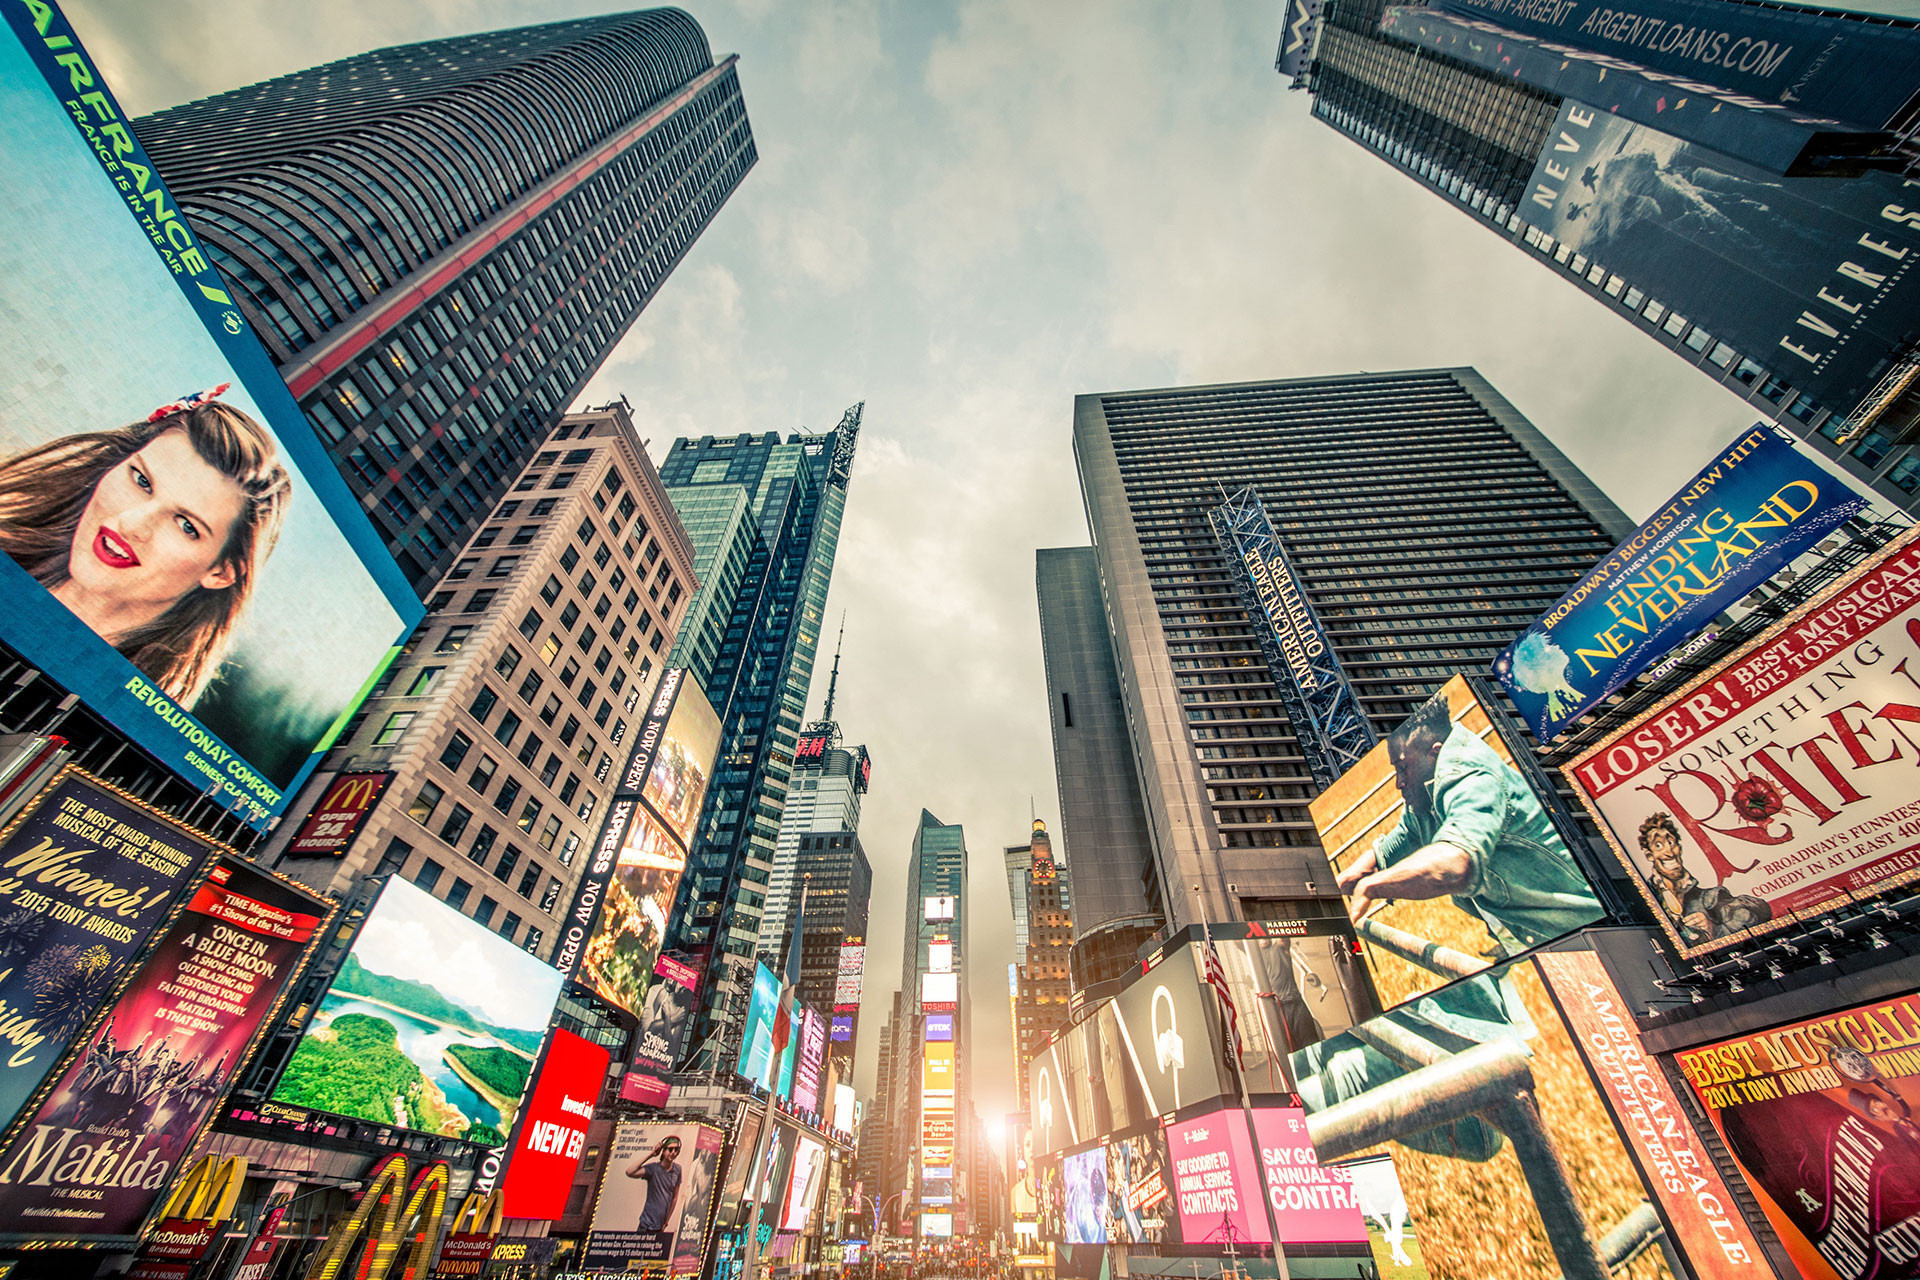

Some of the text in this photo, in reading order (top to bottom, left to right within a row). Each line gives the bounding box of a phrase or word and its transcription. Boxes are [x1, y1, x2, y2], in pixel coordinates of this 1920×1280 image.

[1579, 8, 1793, 78] ARGENTLOANS.COM
[1532, 105, 1595, 209] NEVE
[66, 100, 183, 275] FRANCE IS IN THE AIR
[1543, 430, 1767, 630] BROADWAY'S BIGGEST NEW HIT!
[1608, 513, 1697, 591] MATTHEW MORRISON
[1574, 479, 1819, 677] NEVERLAND
[1603, 507, 1736, 619] FINDING
[1244, 547, 1318, 689] AMERICAN EAGLE
[1267, 556, 1324, 658] OUTFITTERS
[1744, 577, 1920, 699] 2015 TONY AWAR
[1732, 637, 1799, 687] BEST
[626, 668, 682, 791] XPRESS NOW OPEN
[1658, 638, 1885, 780] SOMETHING
[125, 676, 281, 806] REVOLUTIONAY COMFORT
[1581, 680, 1742, 793] LOSER!
[60, 797, 193, 867] THE MOST AWARD-WINNING
[312, 822, 345, 836] 24
[319, 813, 356, 821] OPEN
[52, 813, 181, 878] MUSICAL OF THE SEASON!
[297, 838, 347, 847] HOURS
[1751, 868, 1807, 898] COMEDY
[1807, 861, 1825, 875] IN
[1827, 852, 1847, 869] AT
[1846, 832, 1896, 859] LEAST
[4, 836, 170, 918] Winner!
[12, 889, 137, 944] 2015 TONY AWARDS
[209, 904, 295, 937] #1 Show of the Year!
[224, 895, 293, 926] TIME Magazine's
[575, 879, 601, 925] NOW
[1267, 920, 1308, 928] MARRIOTT
[250, 941, 269, 957] IN
[557, 927, 584, 980] OPEN
[1269, 927, 1307, 935] MARQUIS
[178, 961, 254, 995] OUT BLAZING AND
[181, 933, 278, 980] A BLUE MOON,
[191, 954, 256, 983] A SHOW COMES
[157, 981, 247, 1017] FAITH IN BROADWAY.
[176, 974, 244, 1002] RESTORES YOUR
[176, 1000, 218, 1020] MATILDA
[154, 1007, 167, 1019] IS
[164, 1010, 193, 1026] THAT
[1681, 1041, 1761, 1088] BEST
[1702, 1049, 1920, 1110] 2014 TONY AWARD WINN
[561, 1094, 583, 1116] Invest
[1584, 981, 1752, 1265] AMERICAN EAGLE
[1591, 1032, 1686, 1195] OUTFITTERS
[86, 1123, 131, 1138] Roald Dahl's
[528, 1120, 566, 1157] NEW
[0, 1124, 171, 1190] Matilda
[1177, 1151, 1229, 1175] SAY GOODBYE TO
[1263, 1148, 1317, 1165] SAY GO
[1268, 1167, 1352, 1184] ANNUAL SE
[50, 1187, 104, 1200] THE MUSICAL
[1180, 1174, 1204, 1192] ANNUAL
[1203, 1170, 1233, 1189] SERVICE
[1181, 1188, 1239, 1215] CONTRACTS
[1271, 1185, 1361, 1210] CONTRA
[1795, 1188, 1823, 1213] A
[1817, 1115, 1884, 1280] GENTLEMAN'S
[21, 1207, 105, 1219] MatildaTheMusical.com
[148, 1229, 210, 1246] McDonald's
[444, 1240, 492, 1250] McDonald's
